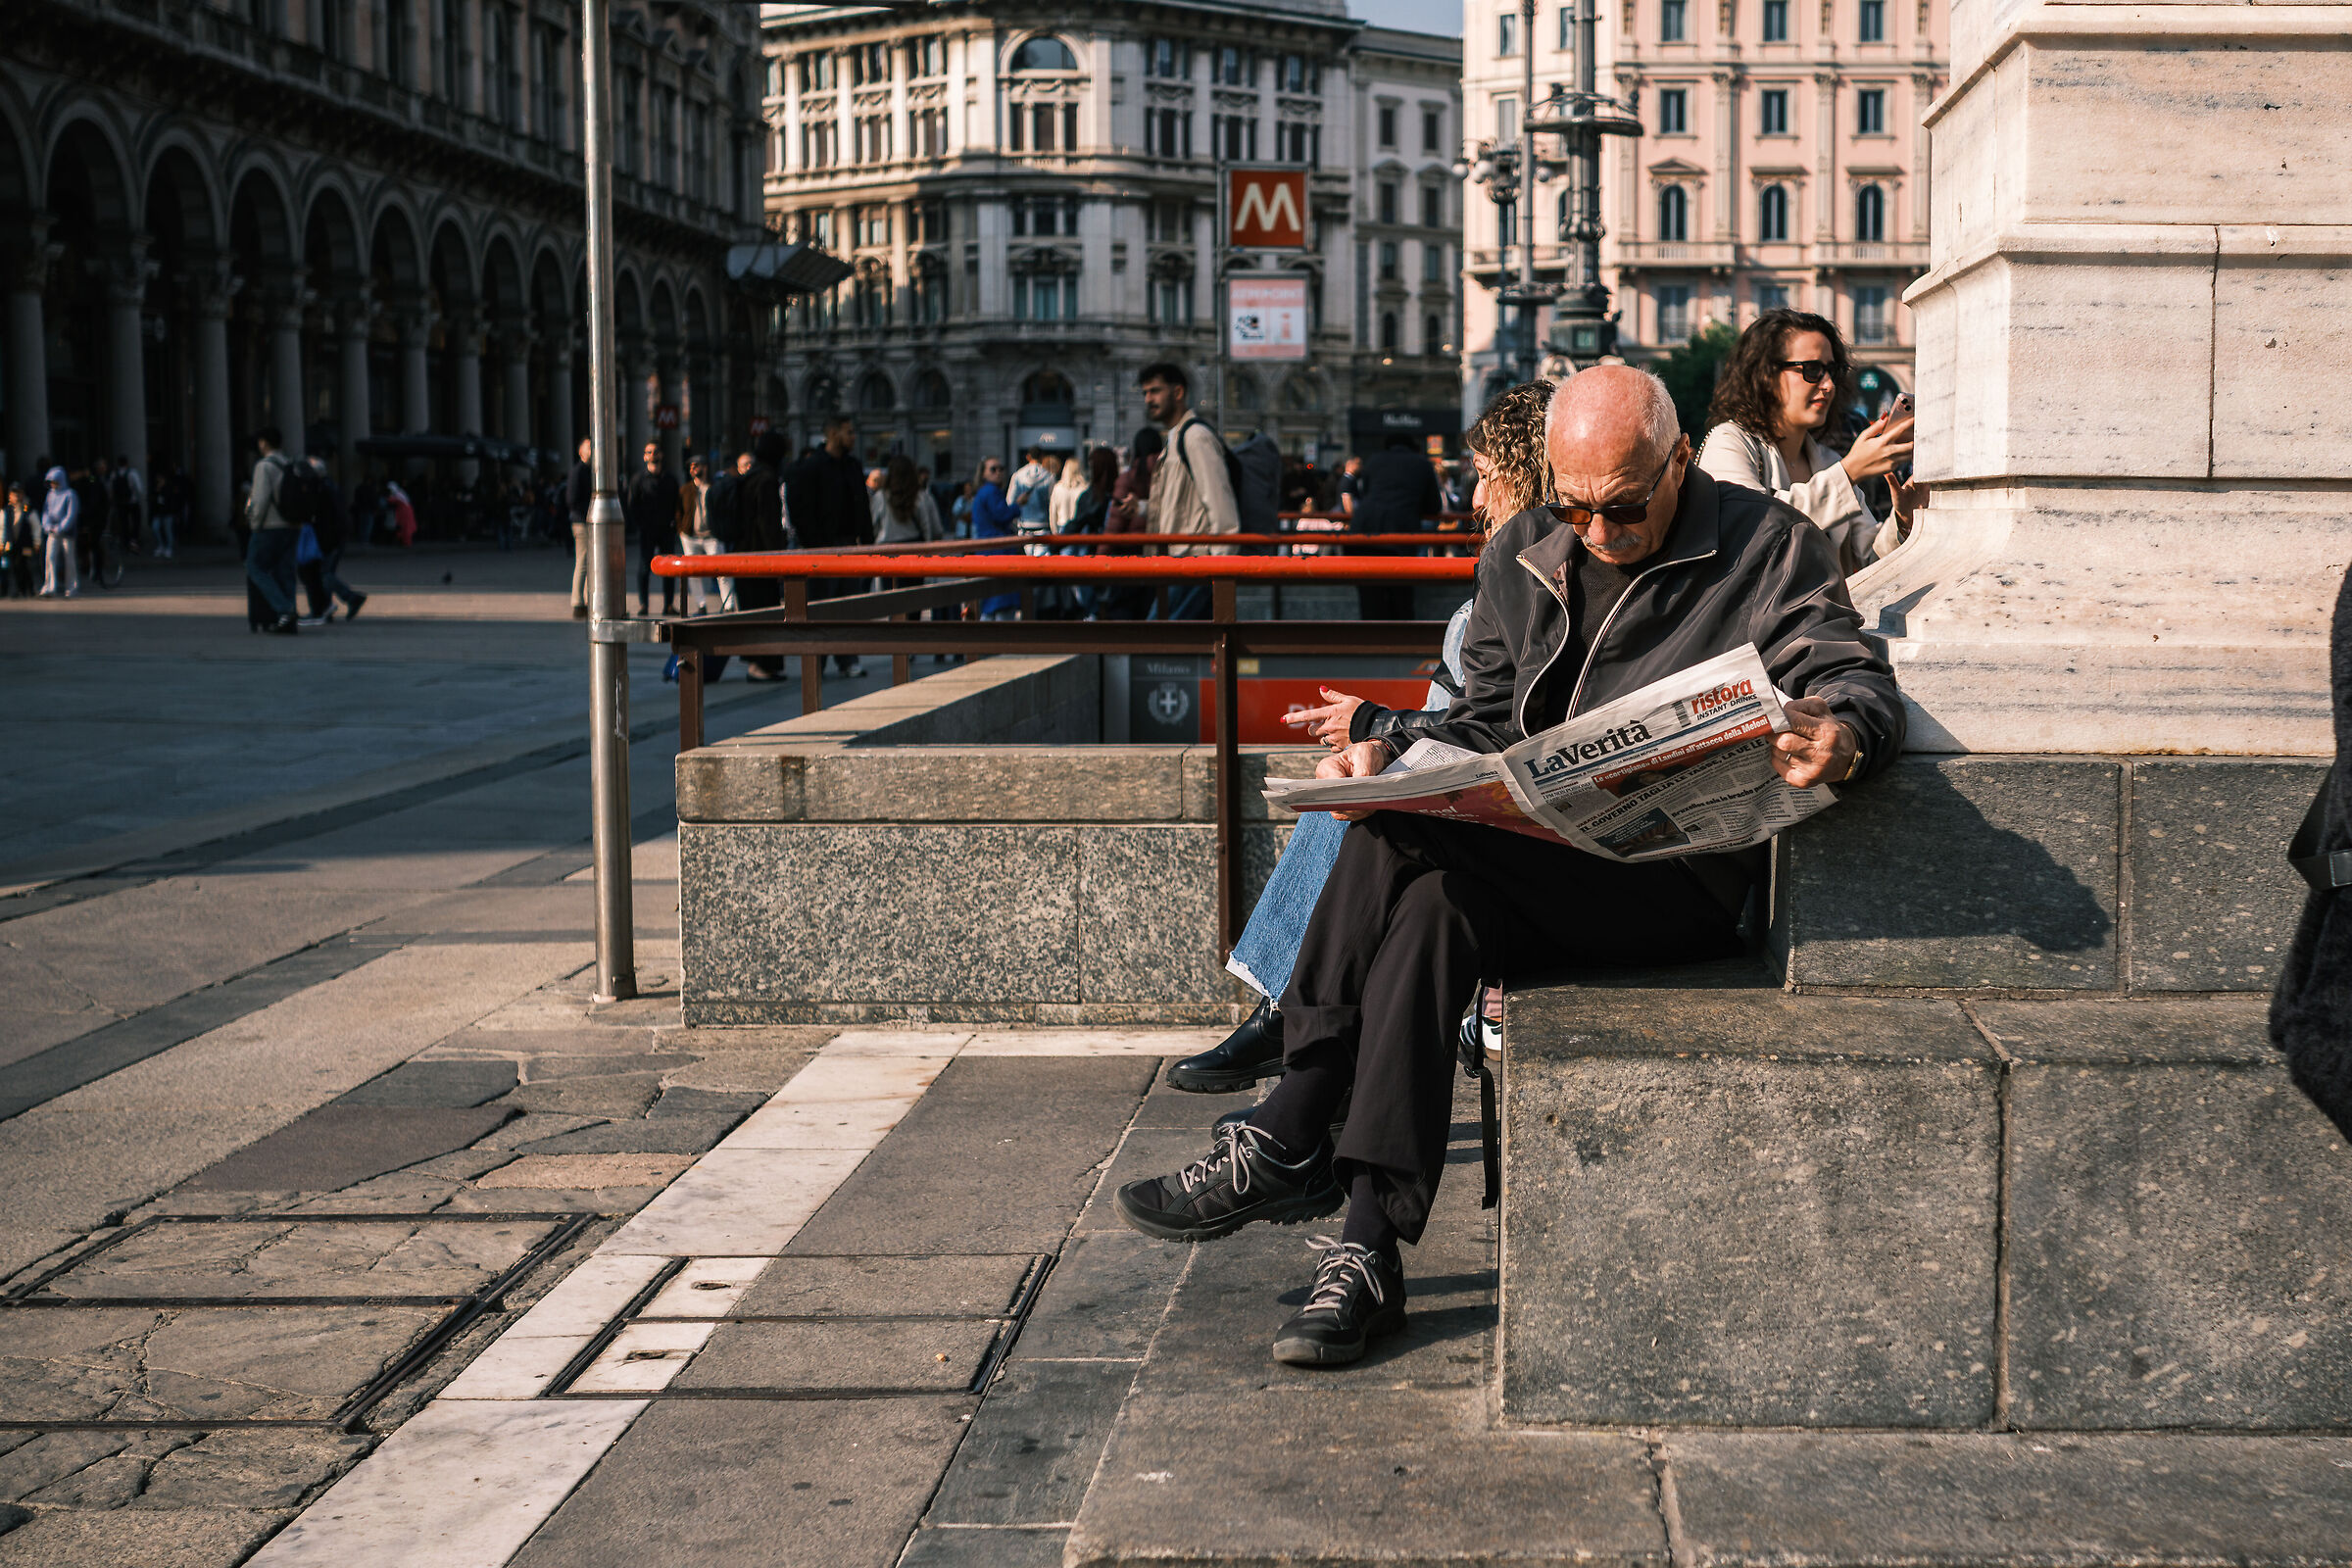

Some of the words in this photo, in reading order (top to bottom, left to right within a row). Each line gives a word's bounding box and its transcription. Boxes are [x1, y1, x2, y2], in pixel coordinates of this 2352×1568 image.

[1234, 182, 1302, 231] M
[1147, 663, 1191, 674] Milano
[1691, 678, 1754, 714] ristora
[1696, 703, 1727, 720] INSTANT
[1730, 693, 1758, 707] DRINKS
[1523, 719, 1653, 779] LaVerità
[1593, 774, 1604, 783] Le
[1650, 757, 1658, 765] di
[1659, 749, 1685, 762] Landini
[1685, 736, 1724, 754] all'attacco
[1724, 728, 1742, 740] della
[1742, 716, 1768, 734] Meloni
[1592, 801, 1639, 827] GOVERNO
[1639, 780, 1675, 802] TAGLIA
[1675, 772, 1688, 782] LE
[1722, 752, 1738, 760] LA
[1737, 743, 1753, 755] UE
[1752, 738, 1764, 749] LE
[1671, 801, 1706, 817] Bruxelles
[1705, 796, 1720, 805] cala
